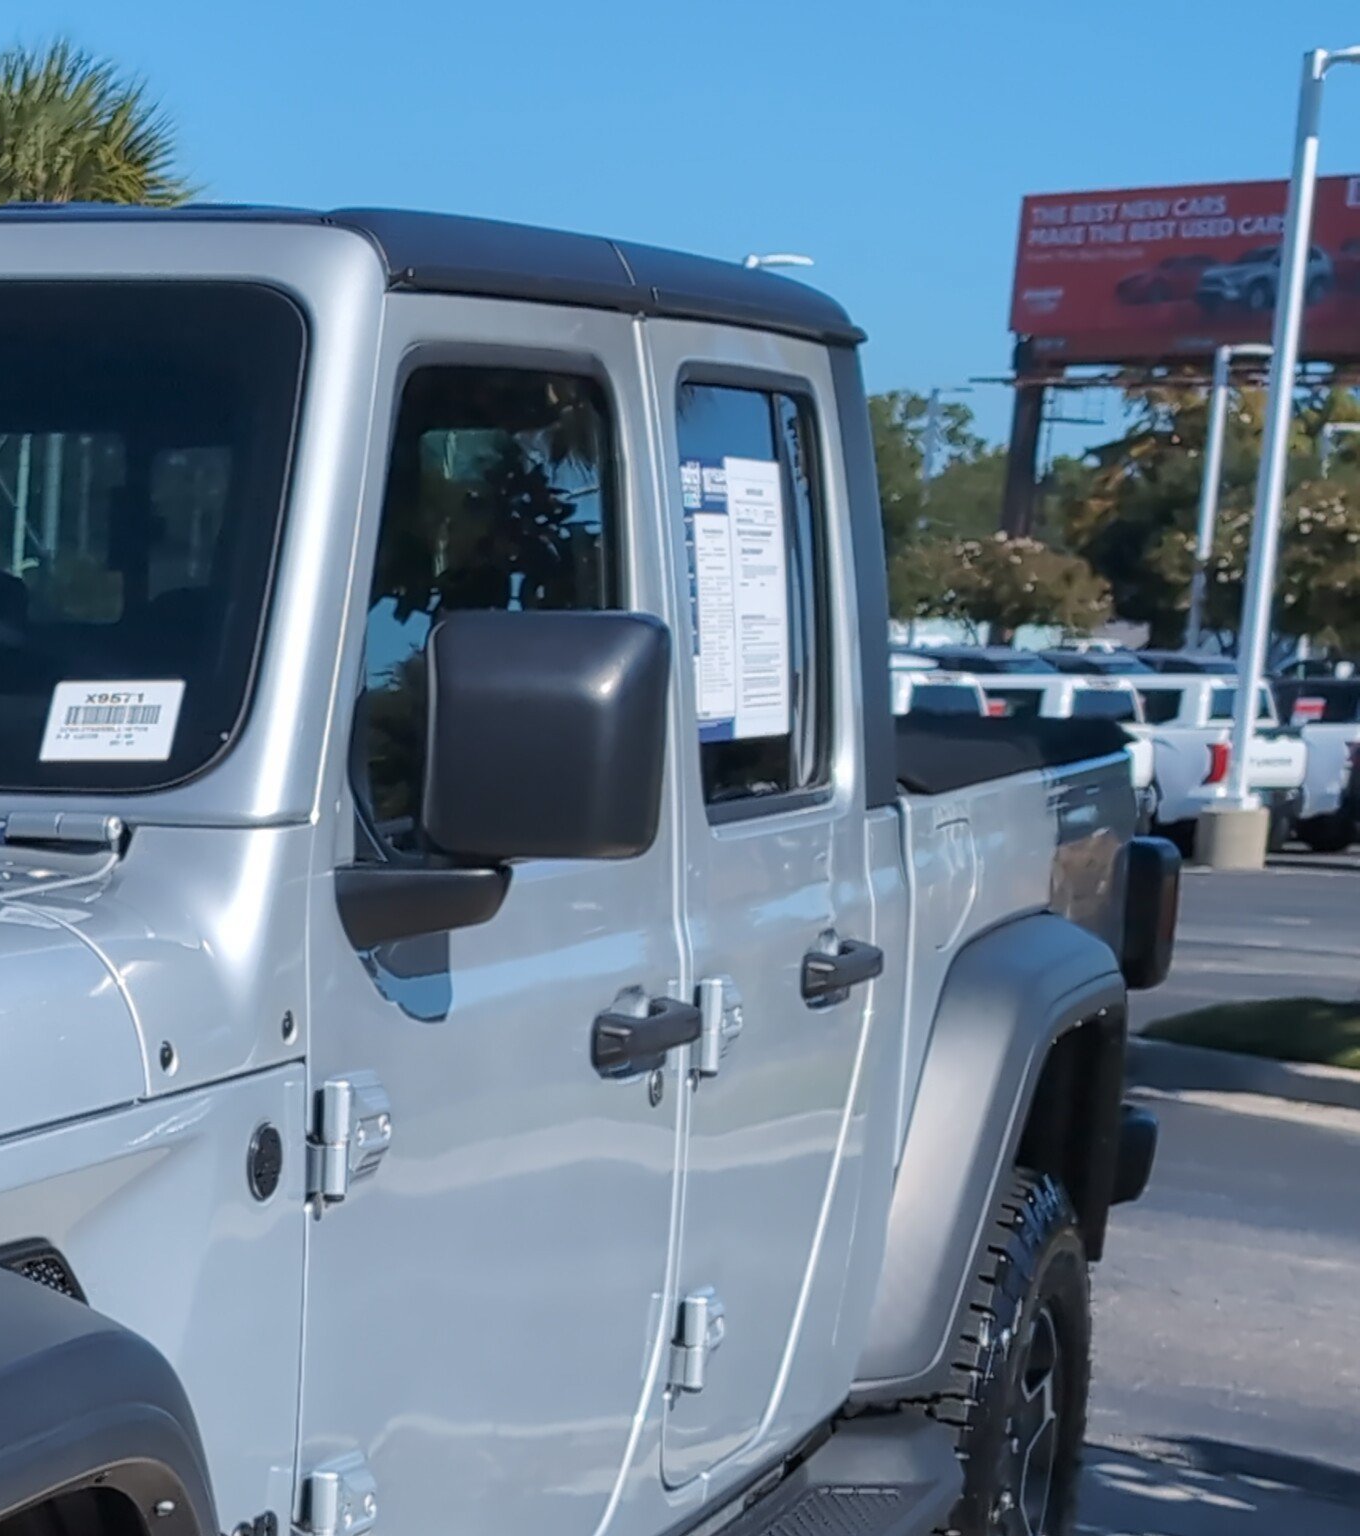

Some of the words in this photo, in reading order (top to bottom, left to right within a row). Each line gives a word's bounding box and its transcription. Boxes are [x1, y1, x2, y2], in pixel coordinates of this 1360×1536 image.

[1032, 205, 1067, 225] THE
[1071, 203, 1118, 223] BEST
[1120, 199, 1169, 219] NEW
[1172, 195, 1227, 217] CARS
[1027, 225, 1085, 245] MAKE
[1088, 222, 1126, 242] THE
[1129, 220, 1176, 242] BEST
[1181, 217, 1236, 239] USED
